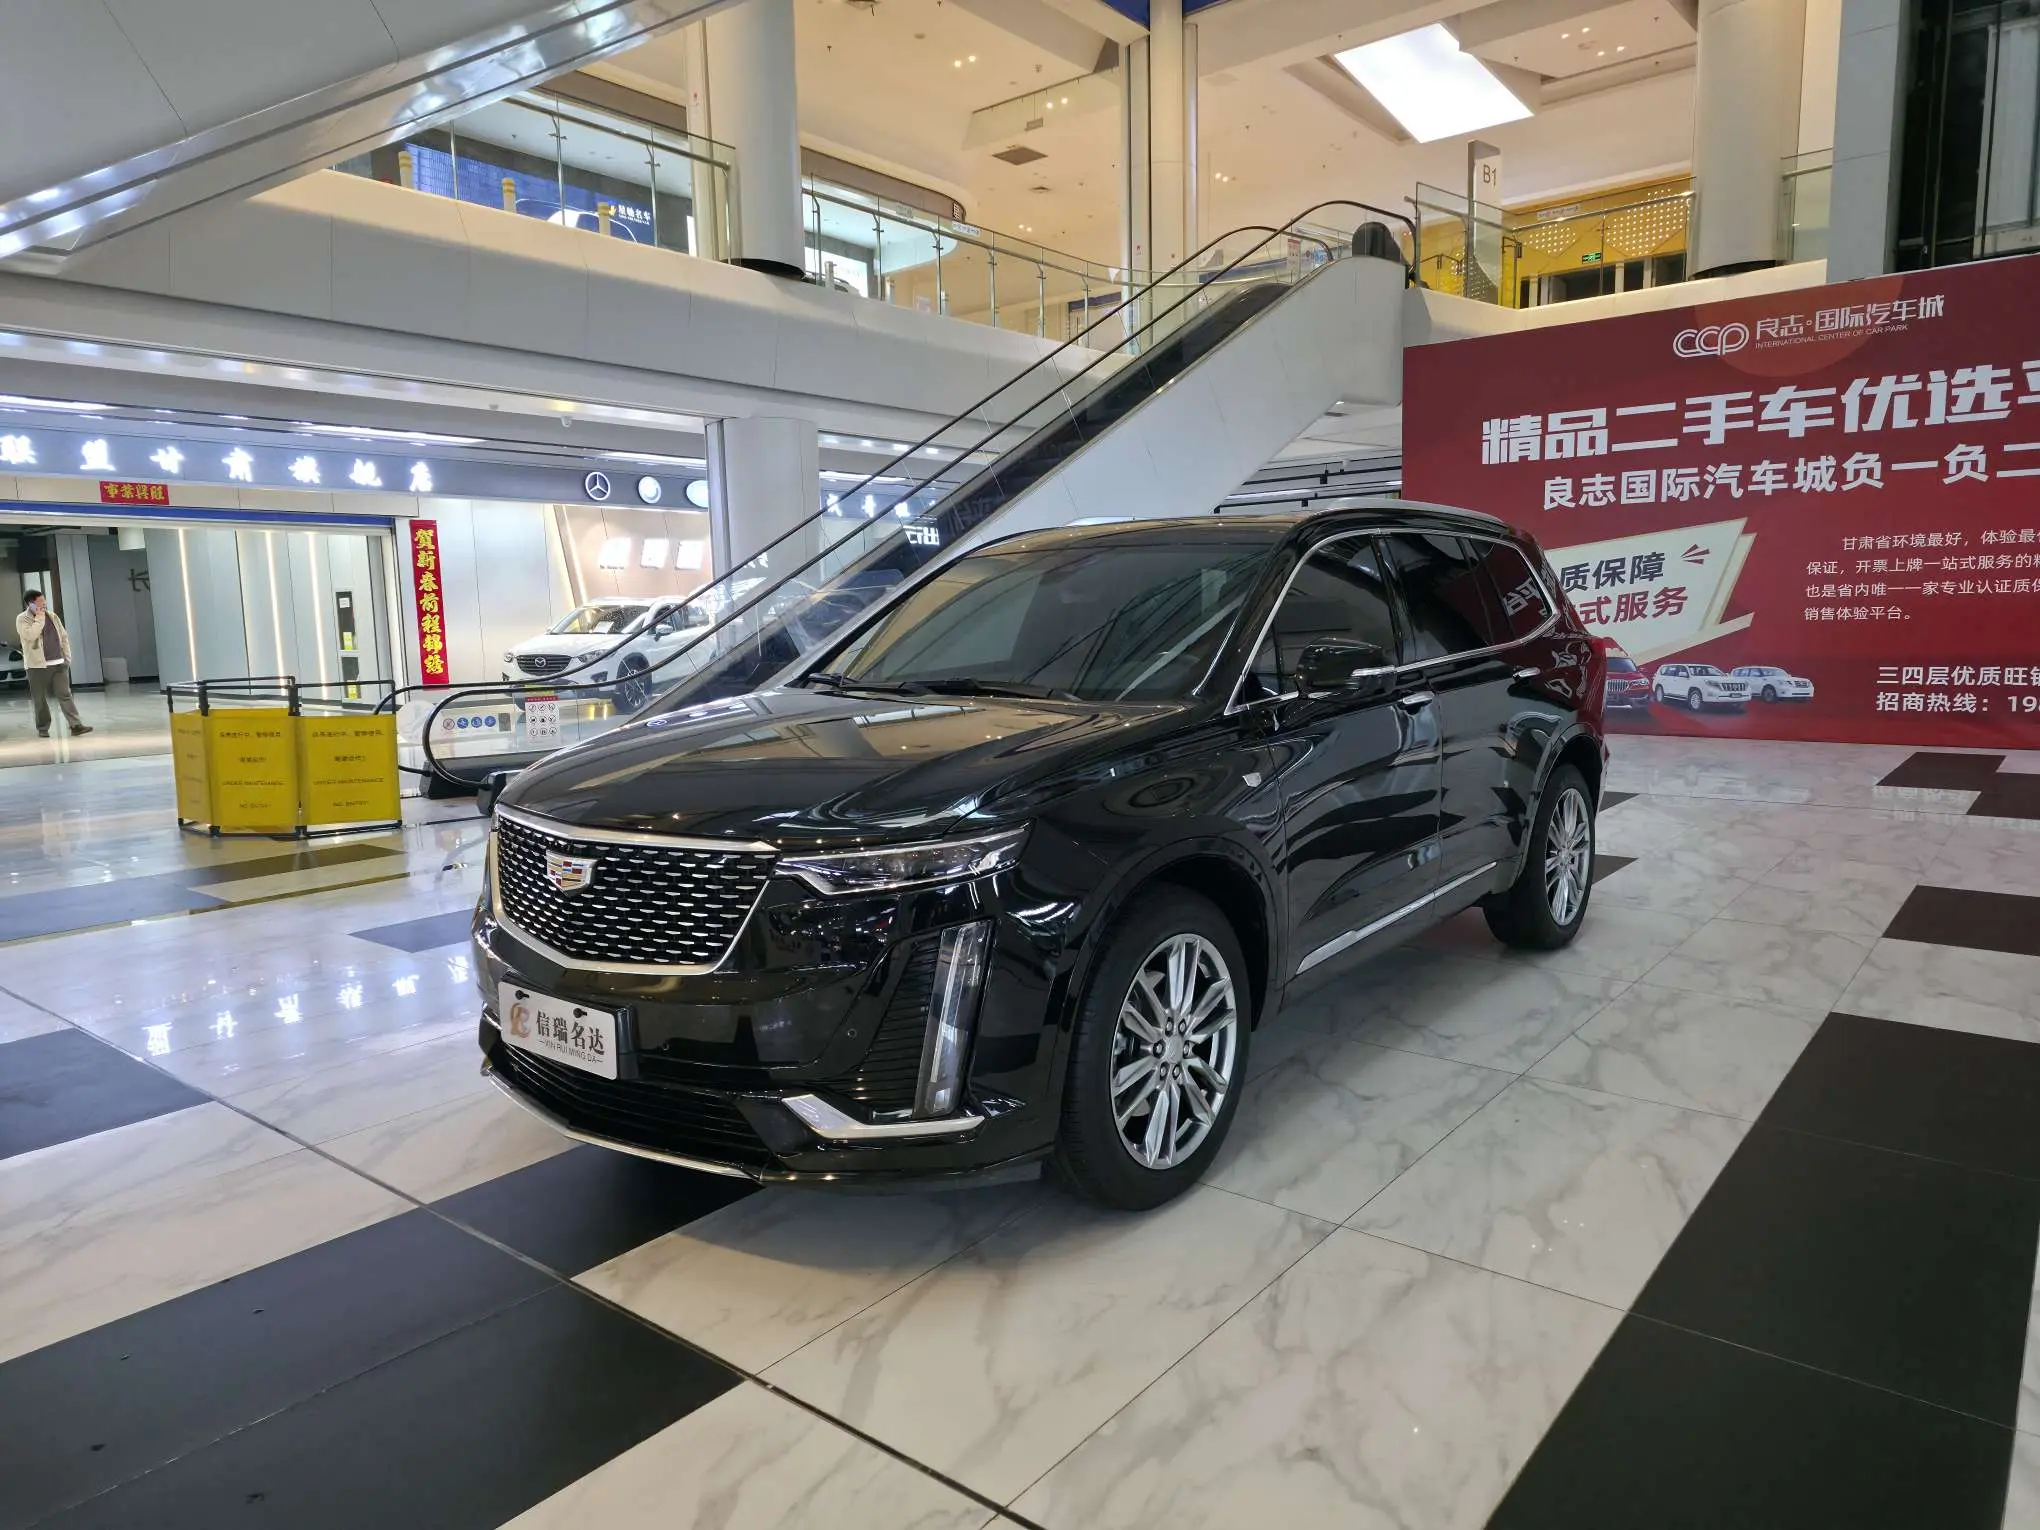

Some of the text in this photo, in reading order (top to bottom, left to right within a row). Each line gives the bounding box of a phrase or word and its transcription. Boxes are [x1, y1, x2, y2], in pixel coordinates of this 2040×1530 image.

[1483, 164, 1496, 187] B1
[1755, 323, 1909, 349] INTERNATIONAL CENTER OF CAR PARK
[1542, 441, 2040, 511] 良志国际汽车城负一负二
[1842, 528, 2040, 551] 甘肃省环境最好，体验最
[1571, 586, 1688, 626] 式服务
[1875, 691, 2040, 714] 招商热线：19
[536, 1009, 605, 1056] 信瑞名达
